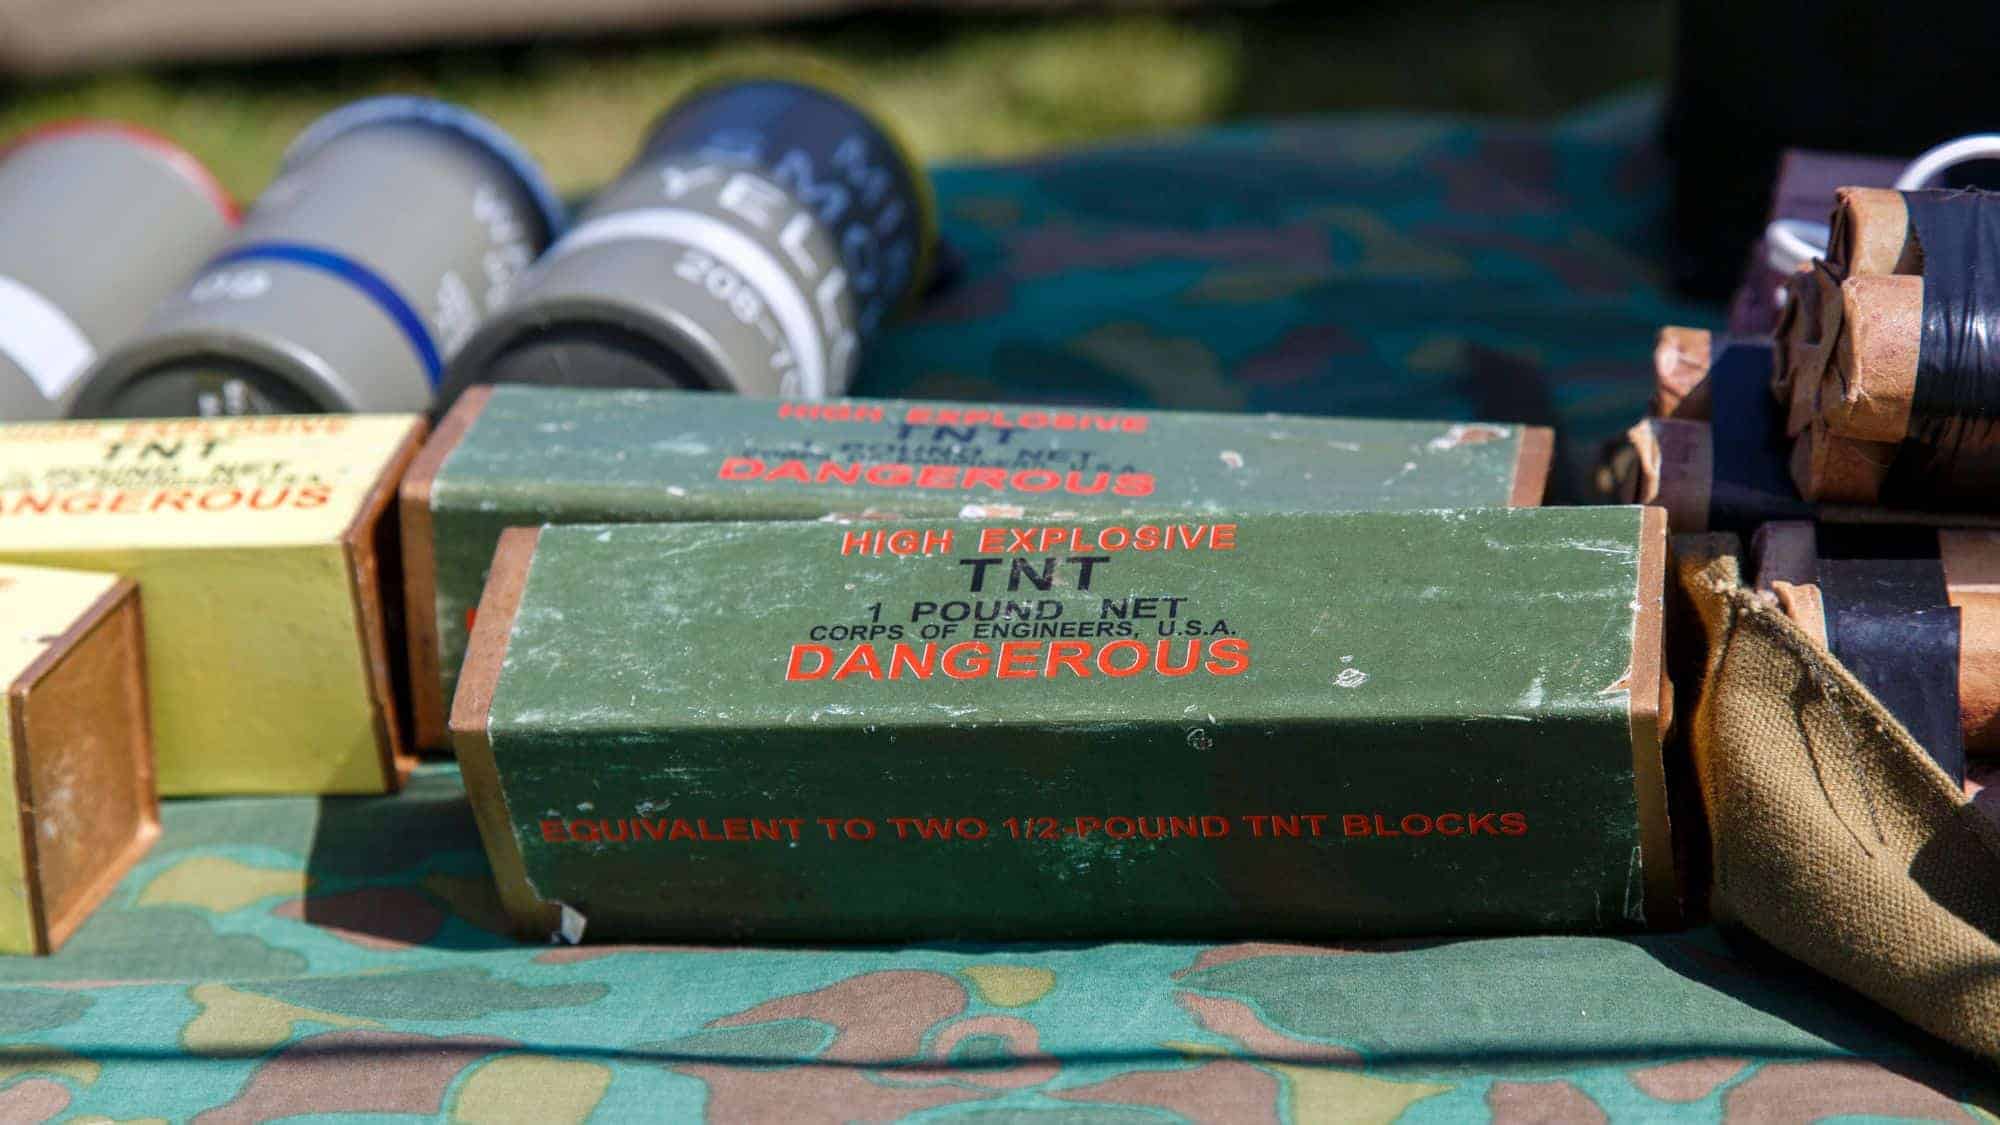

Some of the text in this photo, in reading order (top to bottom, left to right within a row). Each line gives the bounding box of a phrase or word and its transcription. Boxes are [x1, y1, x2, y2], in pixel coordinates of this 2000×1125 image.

[779, 402, 1149, 433] HIGH EXPLOSIVE
[105, 438, 228, 462] TNT
[896, 423, 1026, 446] TNT
[719, 455, 1157, 497] DANGEROUS
[0, 484, 334, 514] NGEROUS
[840, 524, 1239, 556] HIGH EXPLOSIVE
[959, 556, 1111, 593] TNT
[867, 596, 1189, 624] 1 POUND NET
[809, 618, 1238, 642] CORPS OF ENGINEERS, U.S.A.
[785, 637, 1251, 682] DANGEROUS
[540, 816, 807, 843] EQUIVALENT
[817, 816, 877, 842] TO
[886, 816, 989, 841] TWO
[1242, 814, 1328, 839] TNT
[1342, 812, 1529, 838] BLOCKS
